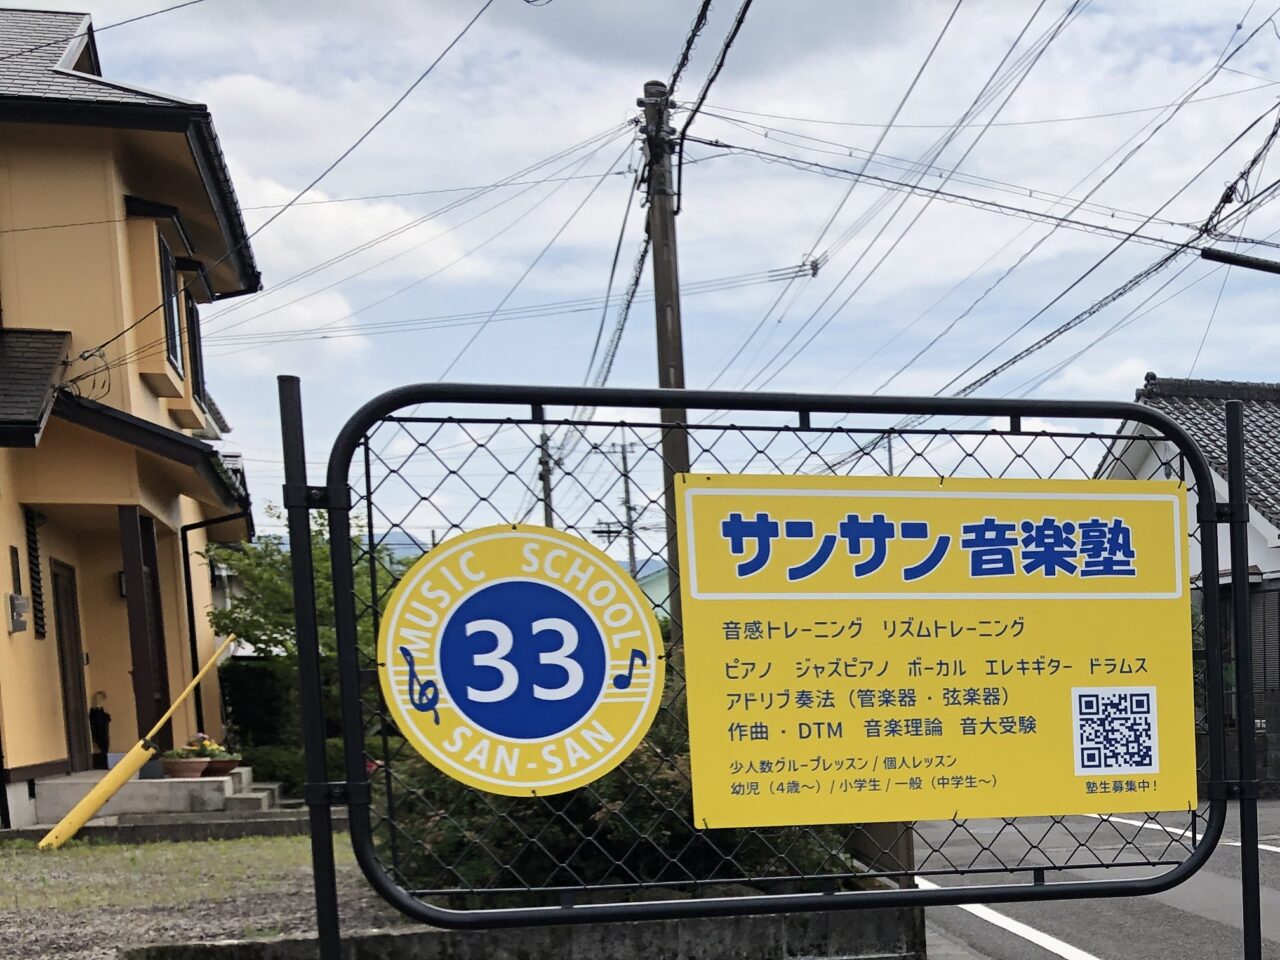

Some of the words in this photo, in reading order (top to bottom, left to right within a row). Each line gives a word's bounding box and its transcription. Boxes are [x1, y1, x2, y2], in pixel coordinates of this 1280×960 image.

[721, 512, 1137, 582] サンサン音楽塾
[397, 551, 486, 659] MUSIC
[521, 542, 643, 649] SCHOOL
[722, 617, 863, 640] 音感トレーニング
[883, 617, 1025, 639] リズムトレーニング
[464, 617, 585, 704] 33
[725, 658, 772, 680] ピアノ
[796, 657, 889, 679] ジャズピアノ
[908, 656, 967, 677] ボーカル
[985, 655, 1073, 676] エレキギター
[1089, 657, 1149, 675] ドラムス
[442, 720, 616, 777] SAN-SAN
[863, 717, 943, 738] 音楽理論
[960, 715, 1037, 736] 音大受験
